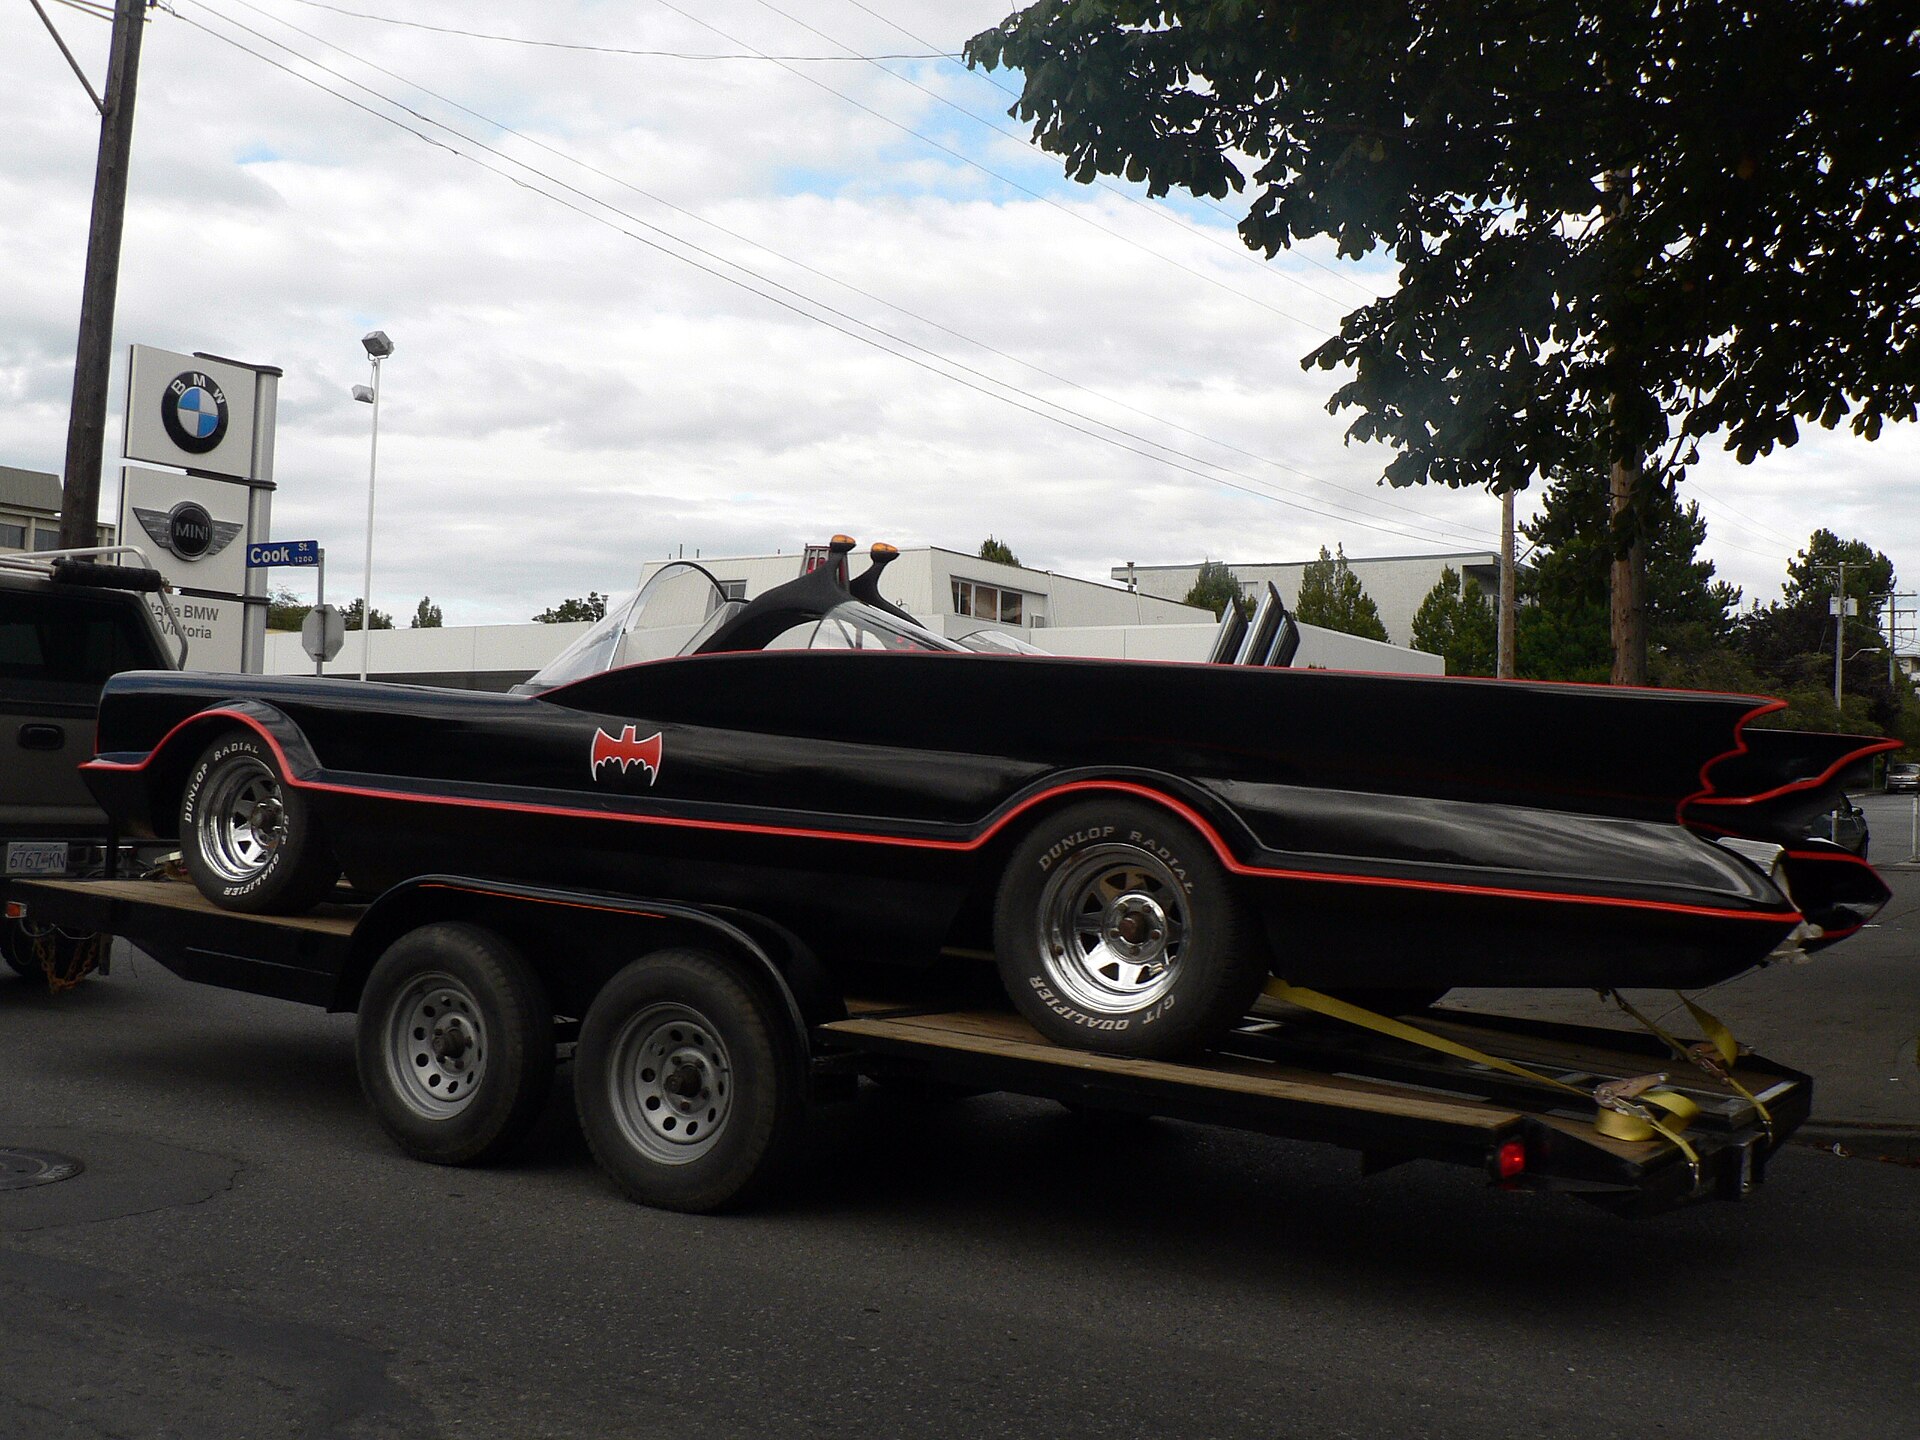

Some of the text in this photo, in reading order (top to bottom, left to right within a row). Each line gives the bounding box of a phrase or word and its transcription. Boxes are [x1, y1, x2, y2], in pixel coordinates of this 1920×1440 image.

[171, 373, 226, 405] BMW
[174, 521, 210, 541] MINI
[250, 546, 290, 564] Cook
[294, 555, 313, 564] 1200
[184, 604, 219, 621] BMW
[184, 742, 260, 824] DUNLOP RADIAL
[223, 853, 280, 896] QUALIFIER
[1039, 826, 1194, 895] DUNLOP RADIAL
[1028, 975, 1176, 1031] G/T QUALIFIER
